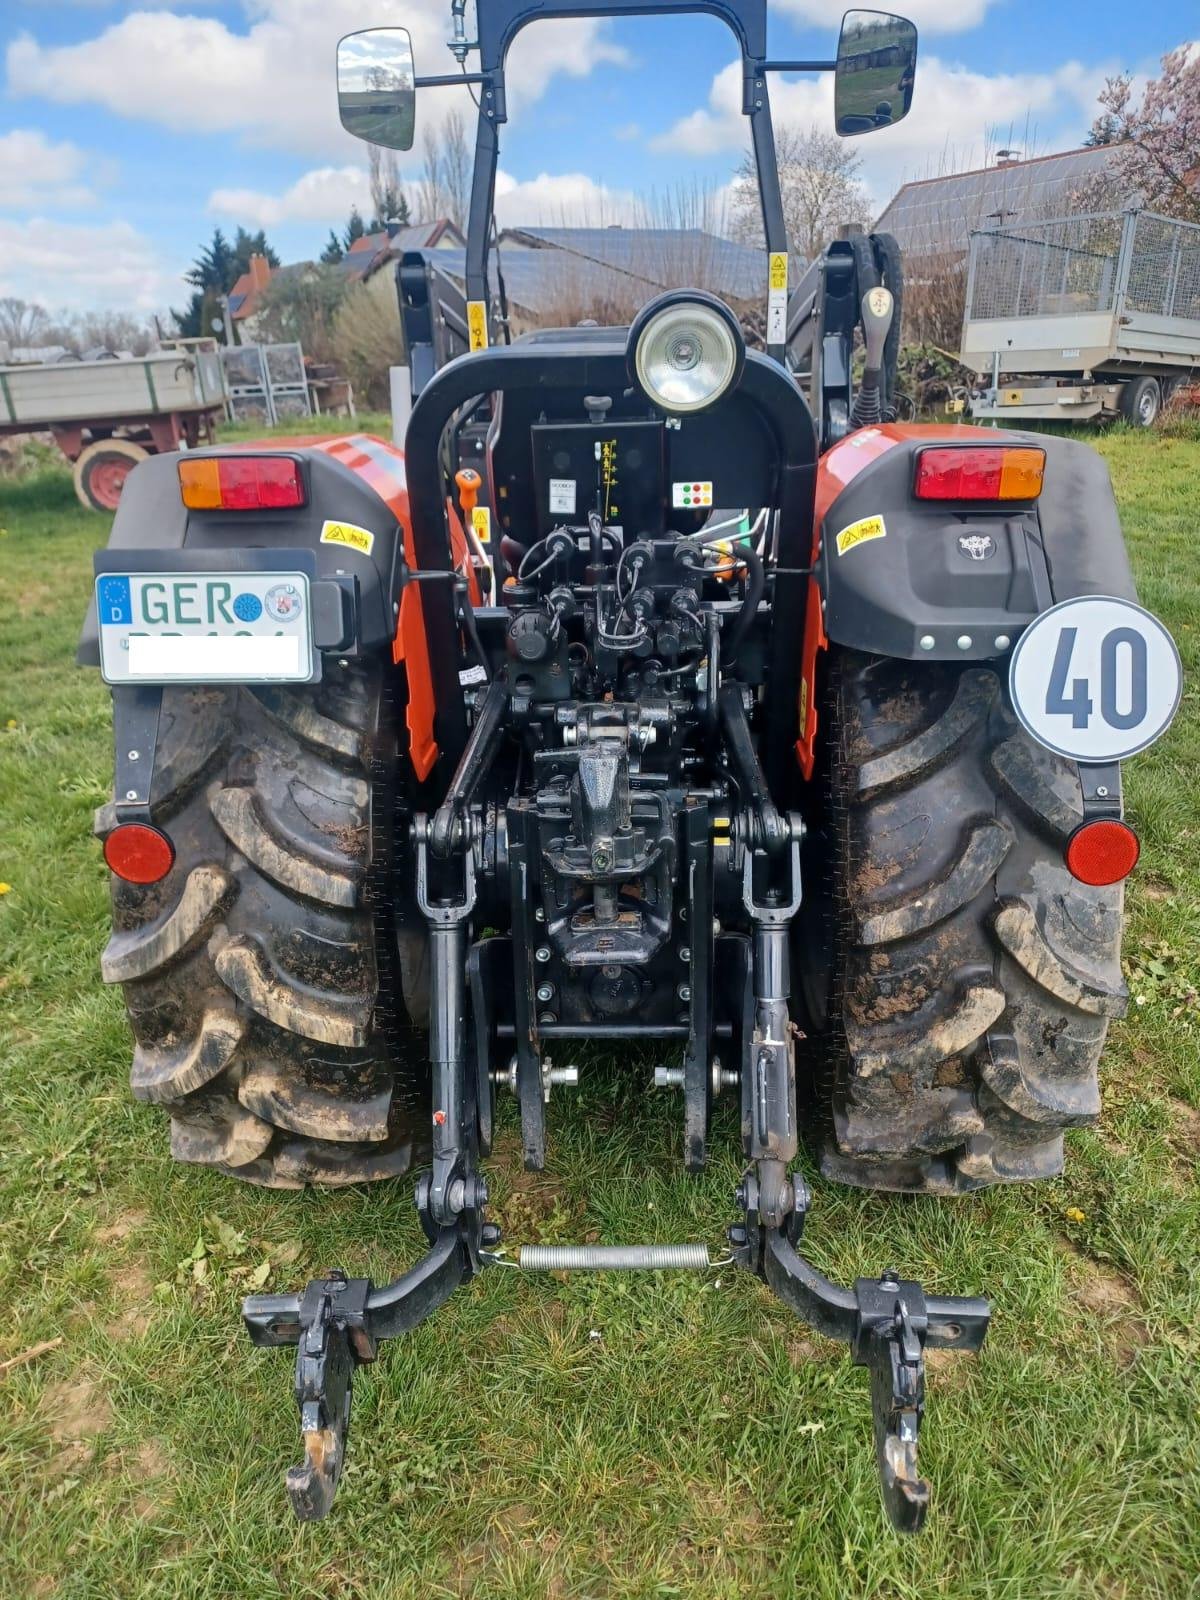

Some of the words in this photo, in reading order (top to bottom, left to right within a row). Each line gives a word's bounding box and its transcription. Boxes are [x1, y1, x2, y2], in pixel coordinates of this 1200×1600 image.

[111, 607, 123, 622] D
[141, 582, 234, 625] GER
[1045, 626, 1147, 731] 40
